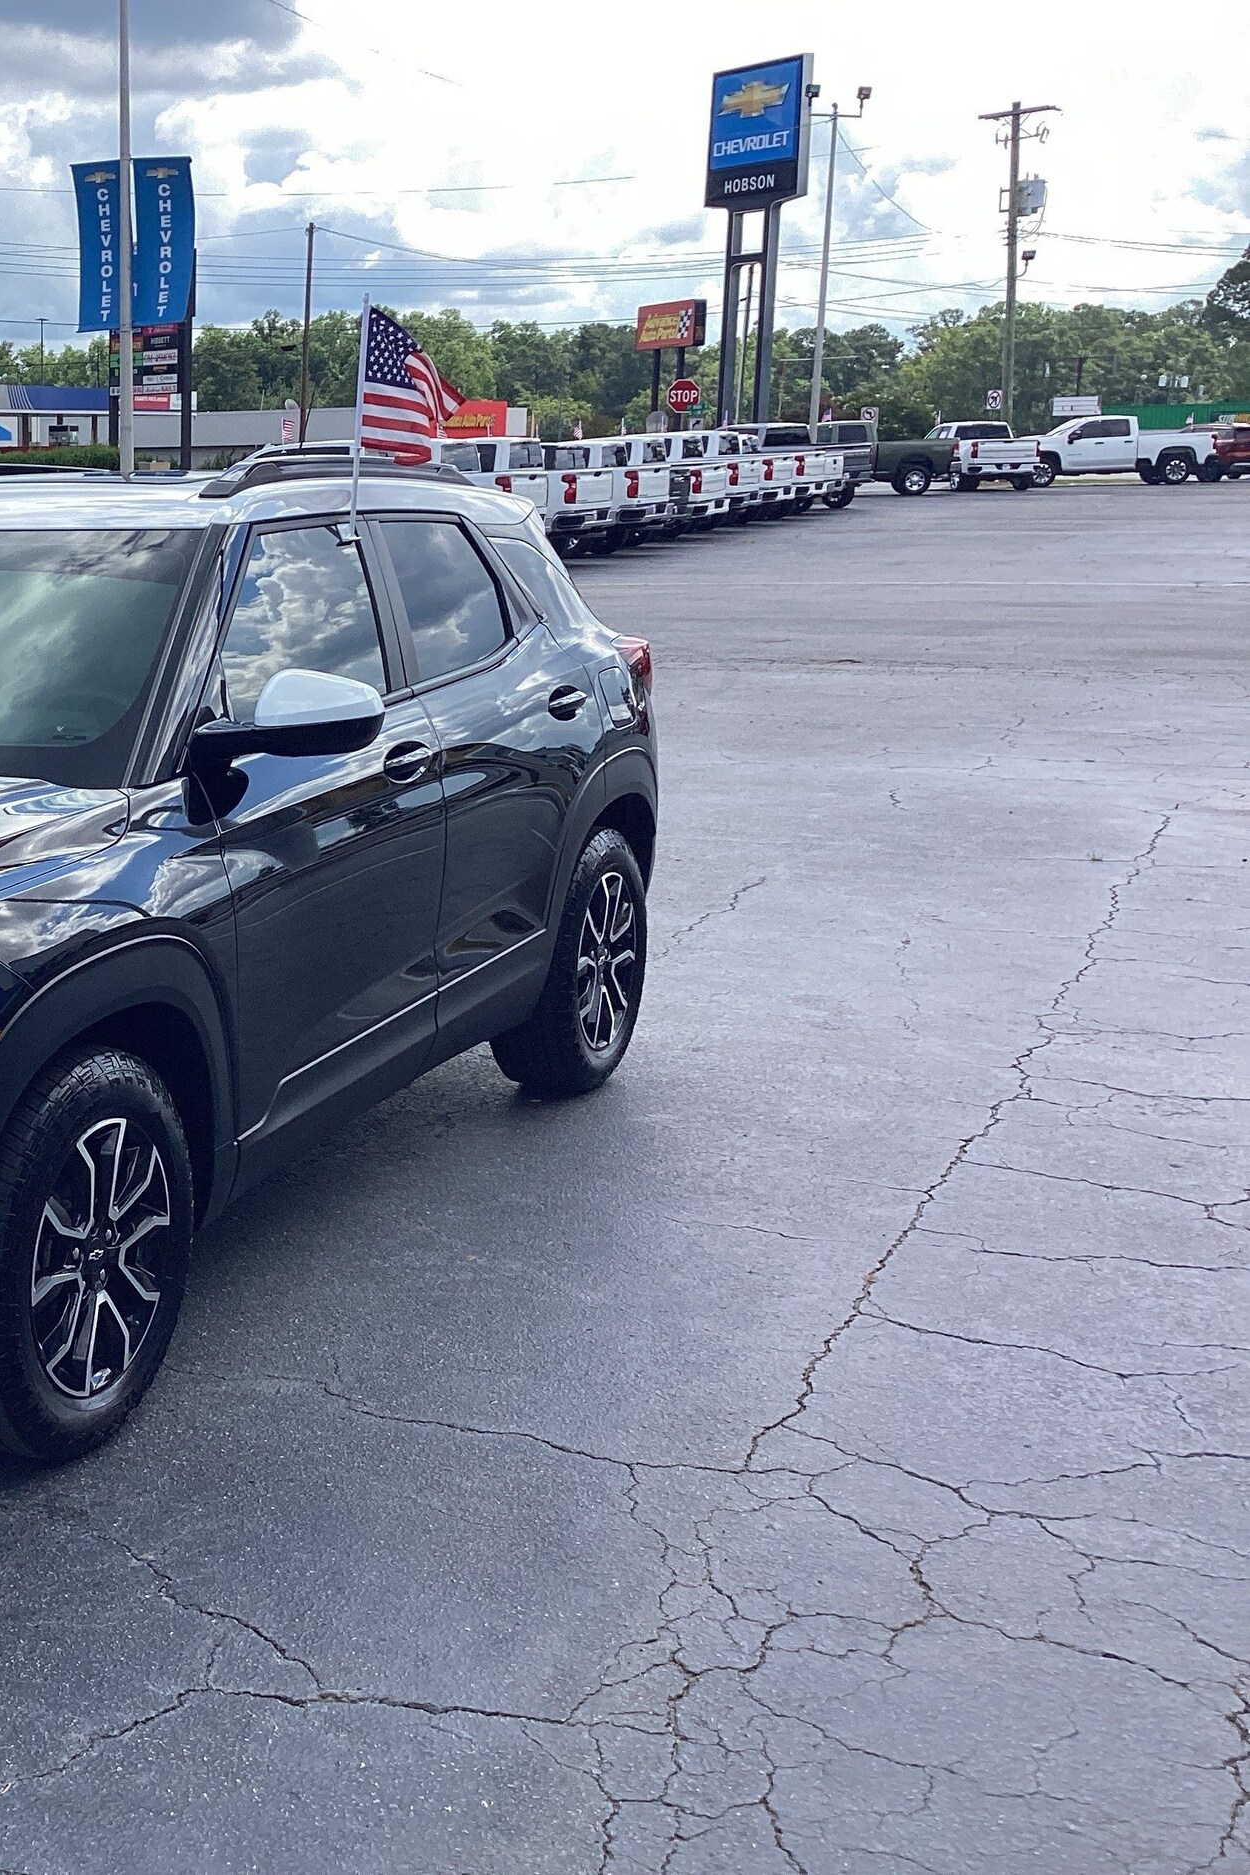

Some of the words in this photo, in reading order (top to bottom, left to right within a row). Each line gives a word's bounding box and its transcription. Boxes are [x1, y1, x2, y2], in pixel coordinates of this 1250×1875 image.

[713, 130, 790, 157] CHEVROLET
[724, 173, 775, 194] HOBSON
[96, 187, 114, 322] CHEVROLET
[156, 183, 172, 317] CHEVROLET
[669, 390, 698, 402] STOP
